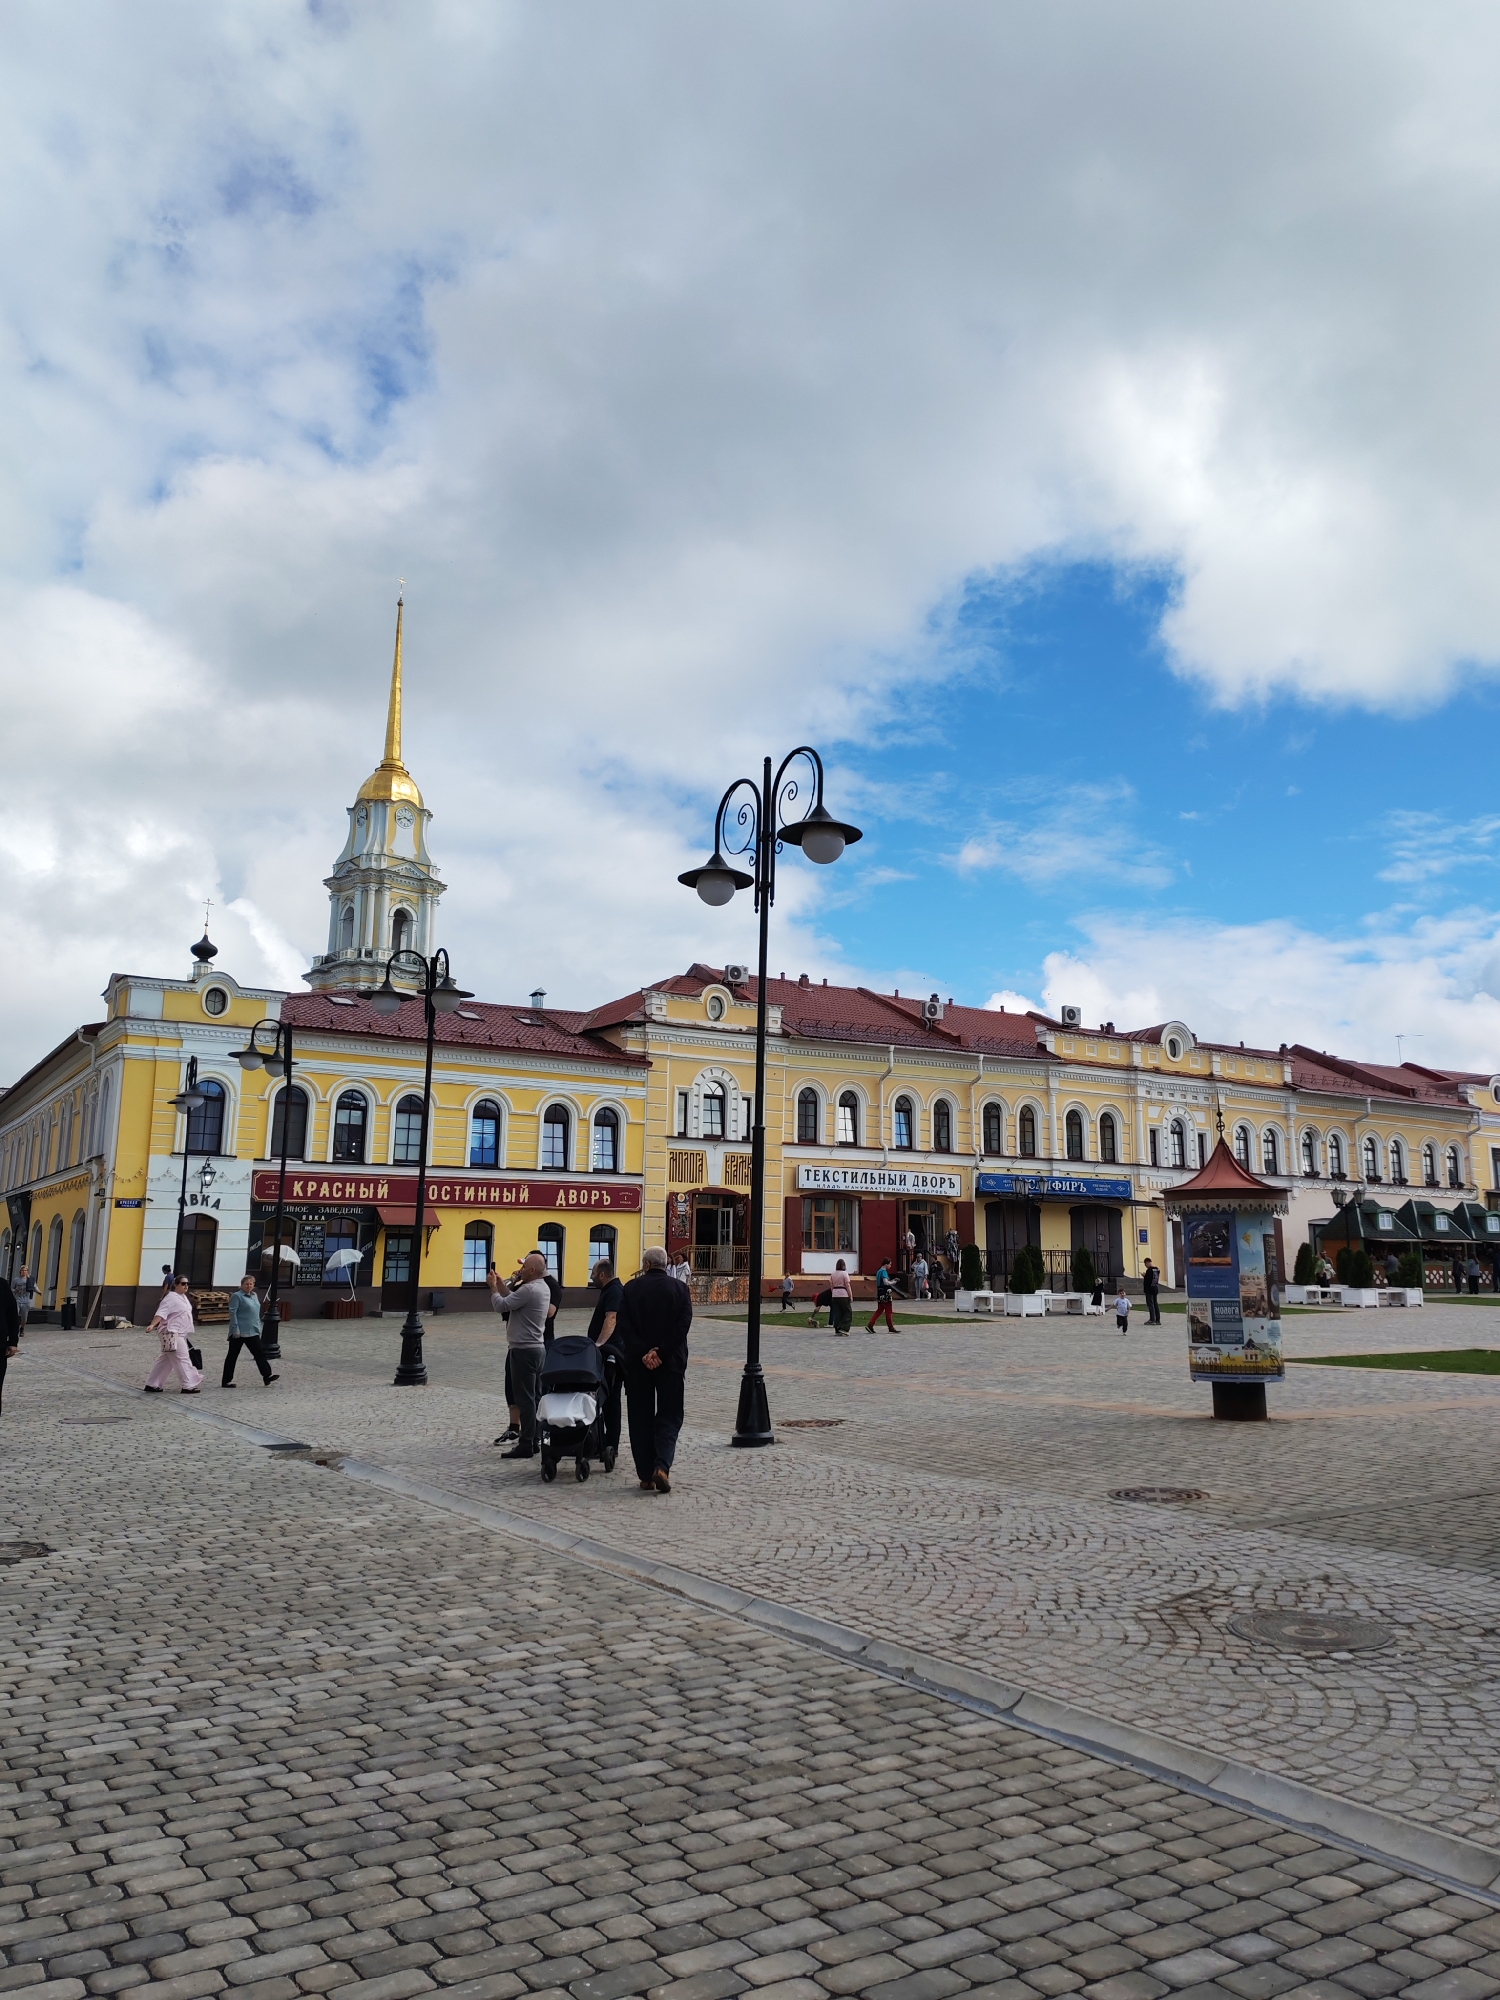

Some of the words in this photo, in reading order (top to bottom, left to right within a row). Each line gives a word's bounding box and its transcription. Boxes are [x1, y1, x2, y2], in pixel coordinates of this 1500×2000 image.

[804, 1169, 907, 1187] ТЕКСТИЛЬНЫЙ
[912, 1174, 956, 1189] ДВОРЪ
[292, 1180, 389, 1199] КРАСНЫЙ
[424, 1185, 529, 1203] ОСТИННЫЙ
[556, 1189, 611, 1206] ДВОРЪ
[262, 1204, 309, 1213] ПИЕЙНОЕ
[1213, 1306, 1240, 1315] МОЛОГА
